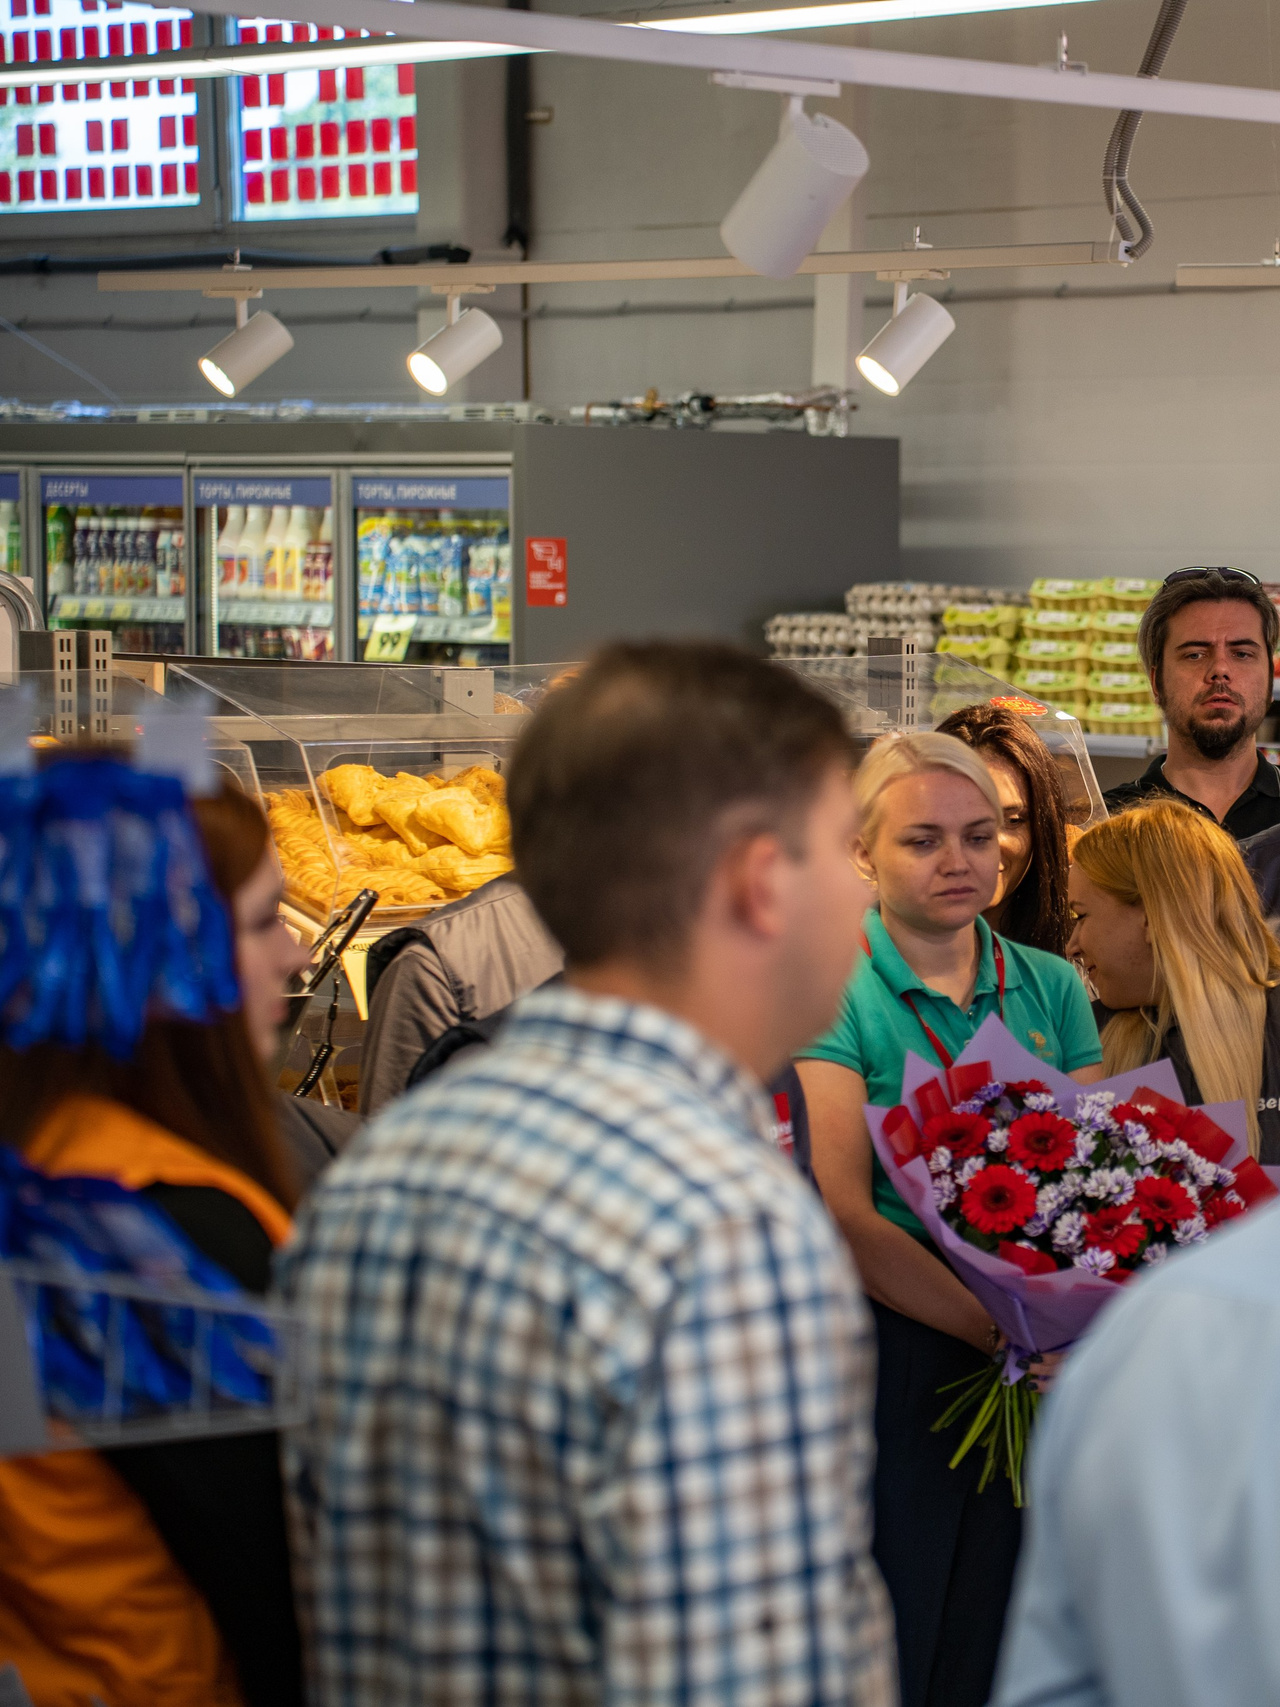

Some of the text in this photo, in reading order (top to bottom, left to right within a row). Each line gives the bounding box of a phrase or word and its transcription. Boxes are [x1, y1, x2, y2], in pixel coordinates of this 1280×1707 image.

[46, 482, 89, 499] ДЕСЕРТЫ
[199, 483, 292, 501] ТОРТЫ, ПИРОЖНЫЕ
[357, 483, 457, 502] ТОРТЫ, ПИРОЖНЫЕ
